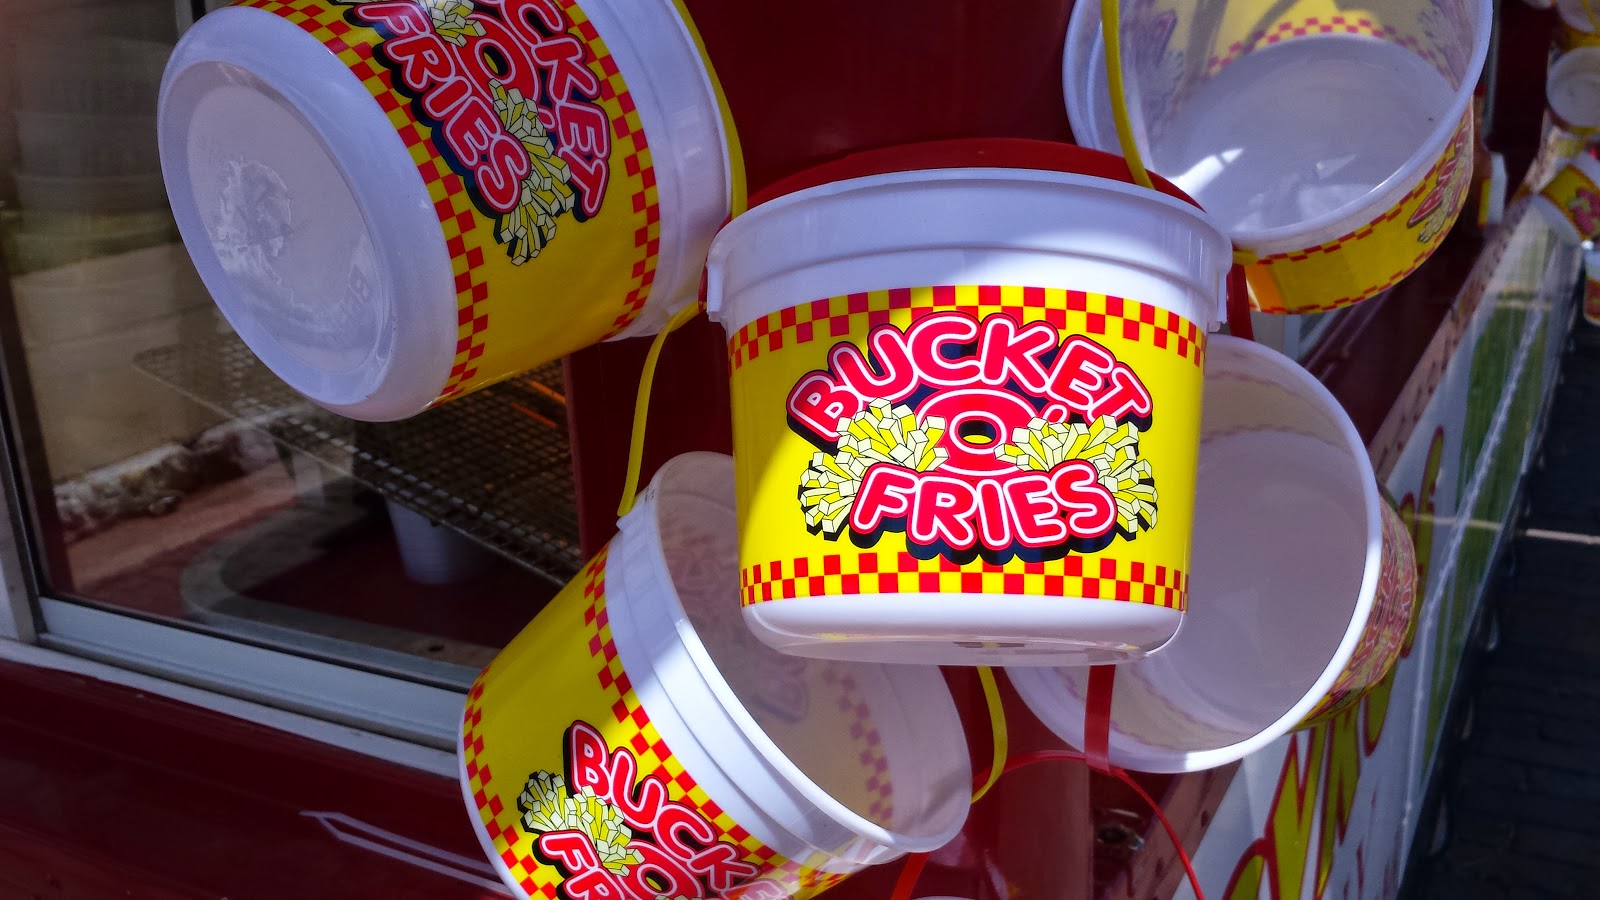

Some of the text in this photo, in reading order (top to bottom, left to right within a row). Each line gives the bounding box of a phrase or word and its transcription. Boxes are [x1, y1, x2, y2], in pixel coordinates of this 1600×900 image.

[356, 3, 530, 214] FRIES
[483, 0, 611, 217] CKET
[786, 311, 1153, 442] BUCKET
[849, 459, 1118, 549] FRIES
